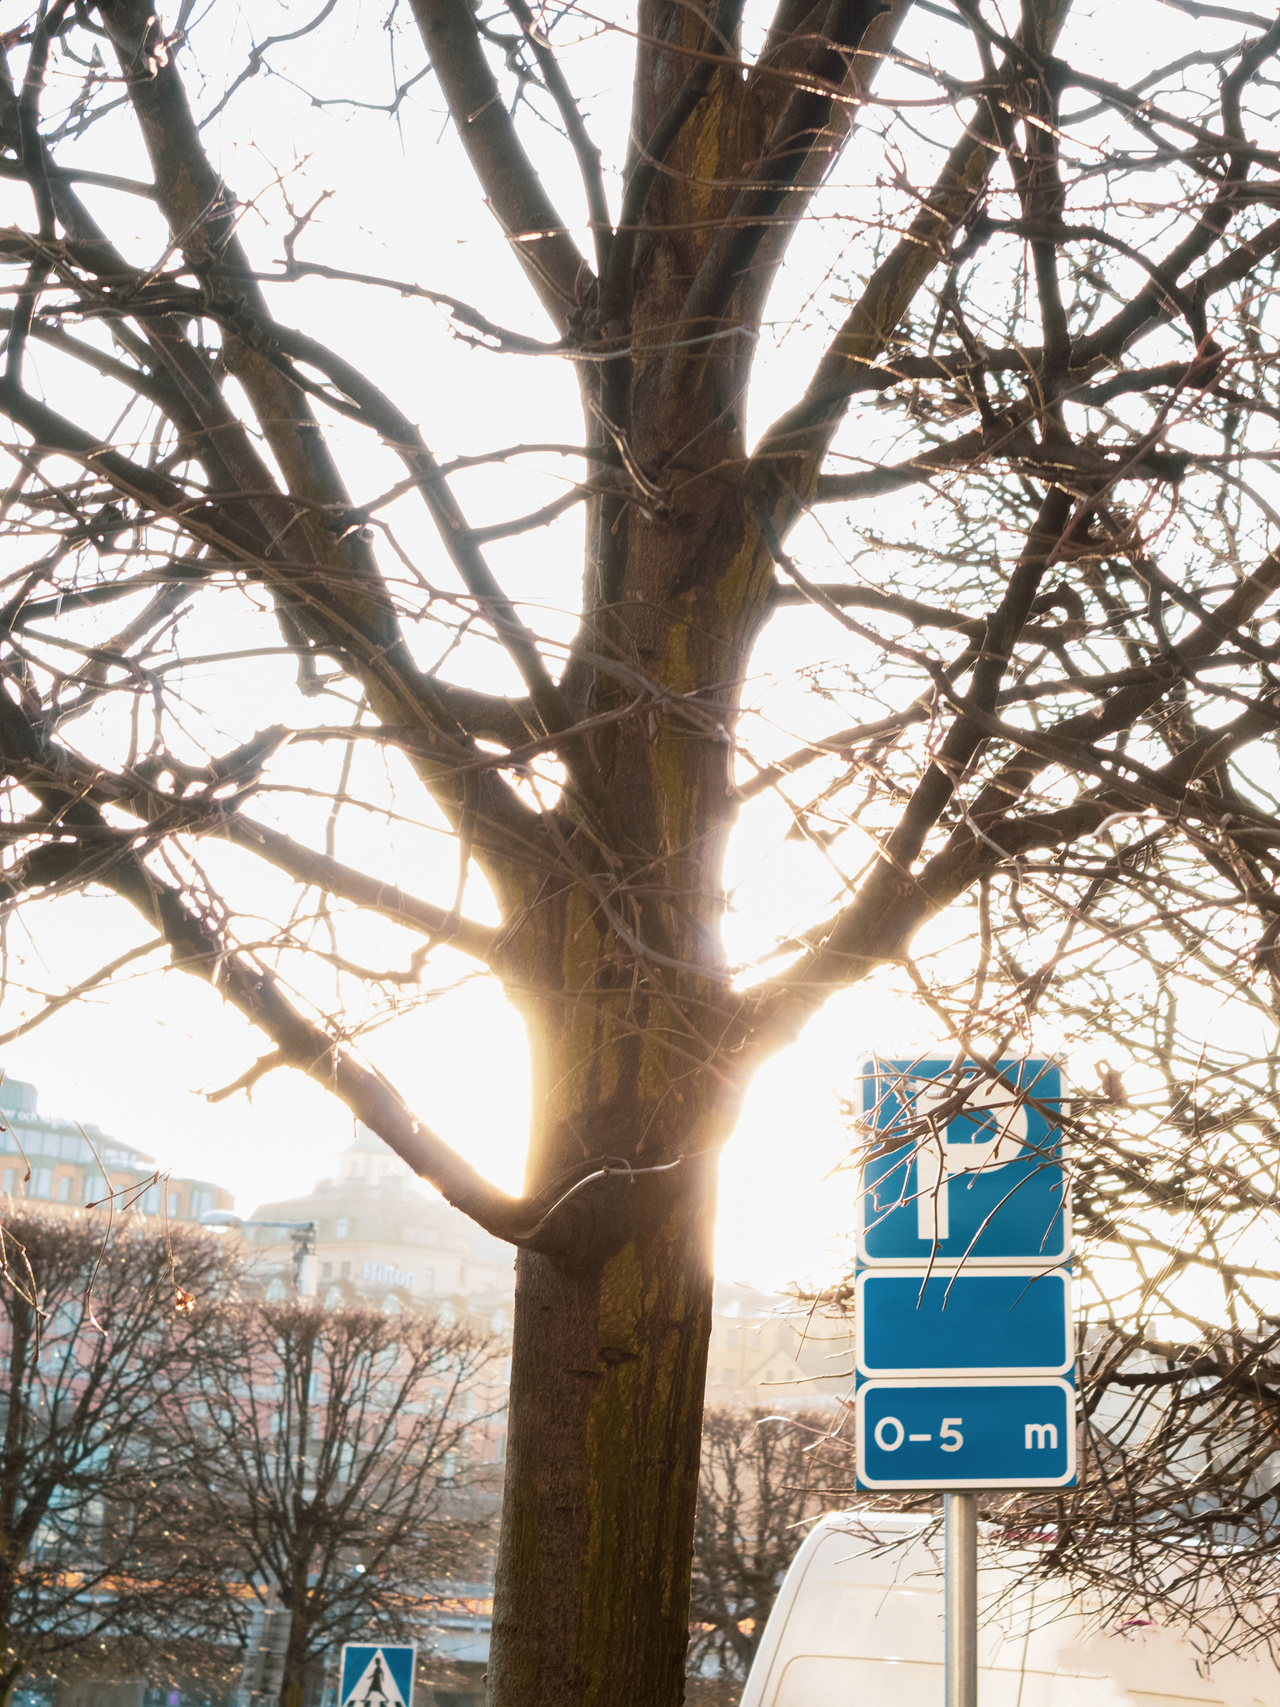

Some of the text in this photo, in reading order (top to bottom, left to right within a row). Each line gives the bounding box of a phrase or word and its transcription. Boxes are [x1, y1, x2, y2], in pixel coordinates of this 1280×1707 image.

[916, 1077, 1028, 1240] P
[362, 1261, 416, 1287] Hilton
[1025, 1423, 1058, 1450] m
